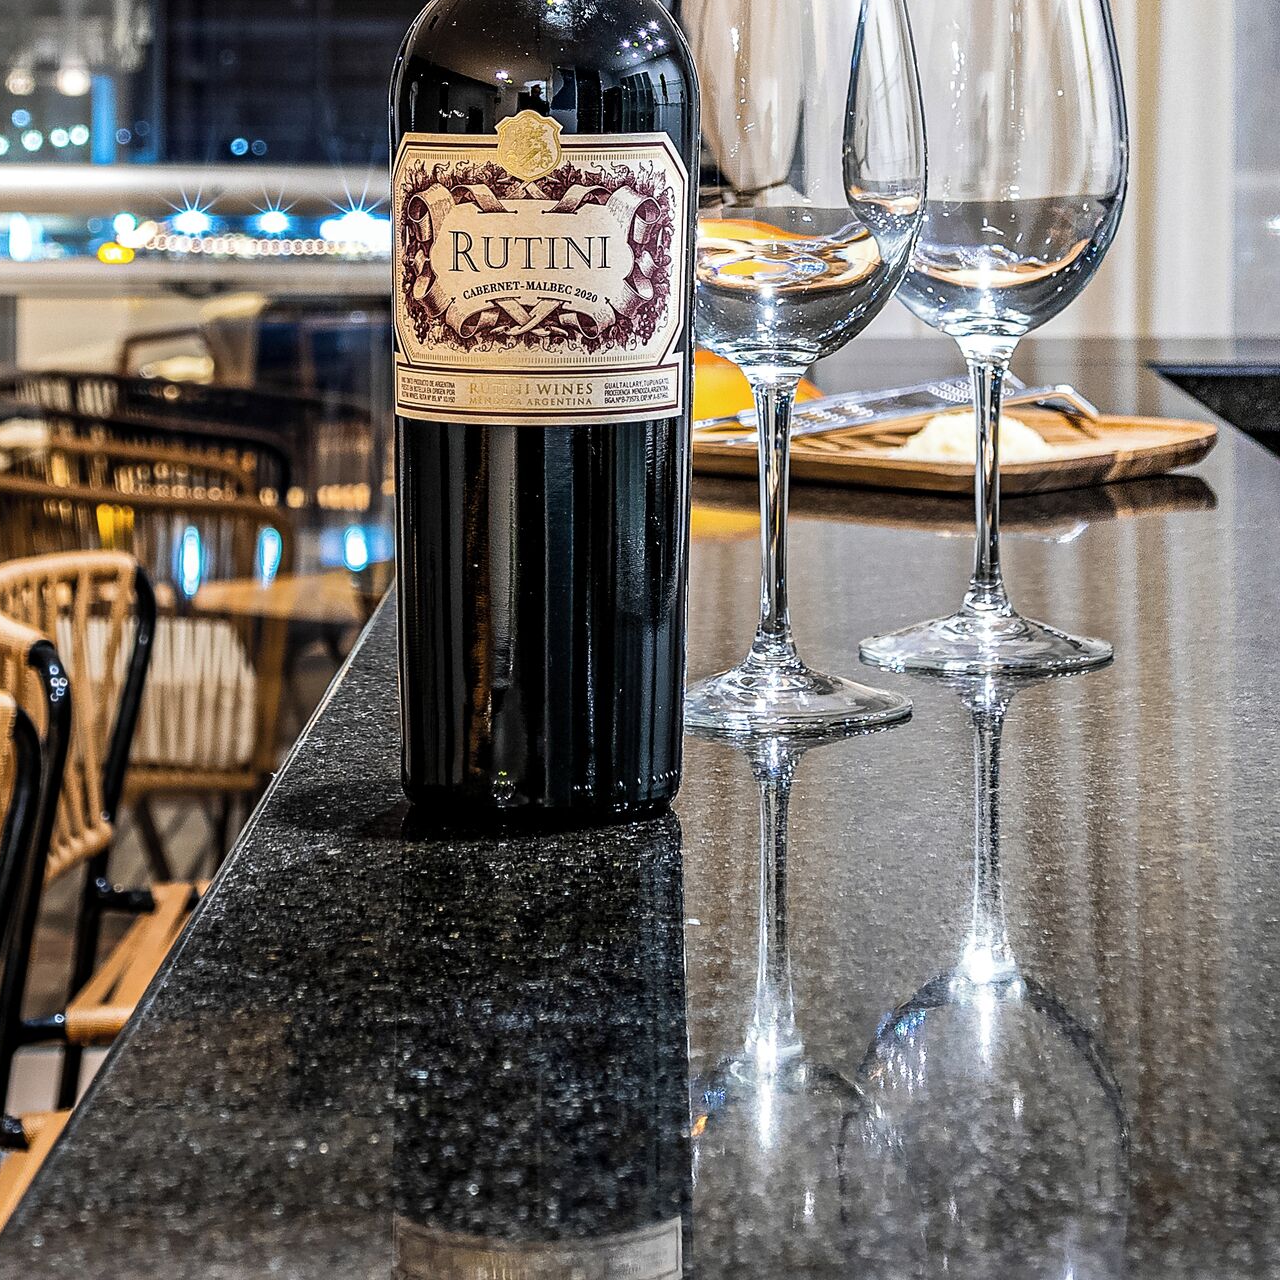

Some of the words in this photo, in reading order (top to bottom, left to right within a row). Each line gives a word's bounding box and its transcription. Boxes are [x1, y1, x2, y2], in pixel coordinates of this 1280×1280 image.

[448, 230, 612, 273] RUTINI
[463, 281, 573, 300] CABERNET-MALBEC
[574, 287, 598, 303] 2020
[469, 382, 530, 395] RUTINI
[536, 382, 593, 395] WINES
[526, 397, 593, 406] ARGENTINA
